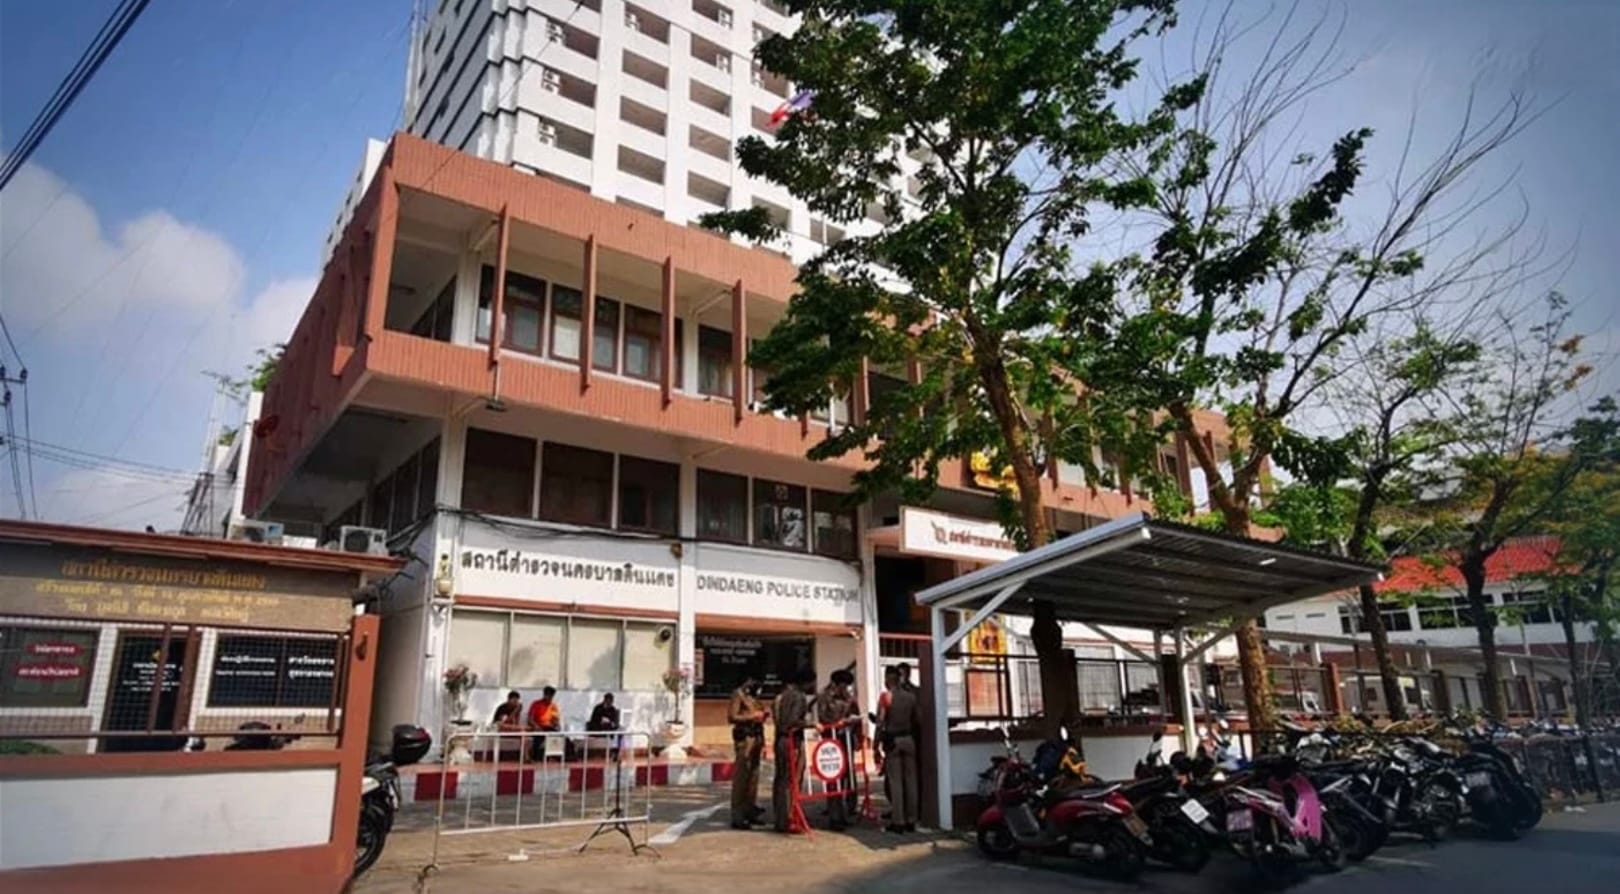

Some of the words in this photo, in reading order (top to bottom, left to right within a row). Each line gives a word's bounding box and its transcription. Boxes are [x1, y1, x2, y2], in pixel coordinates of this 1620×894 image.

[462, 549, 675, 587] สถานีตำรวจนครบาลดินแดง
[697, 575, 764, 594] DINDAENG
[767, 582, 811, 599] POLICE
